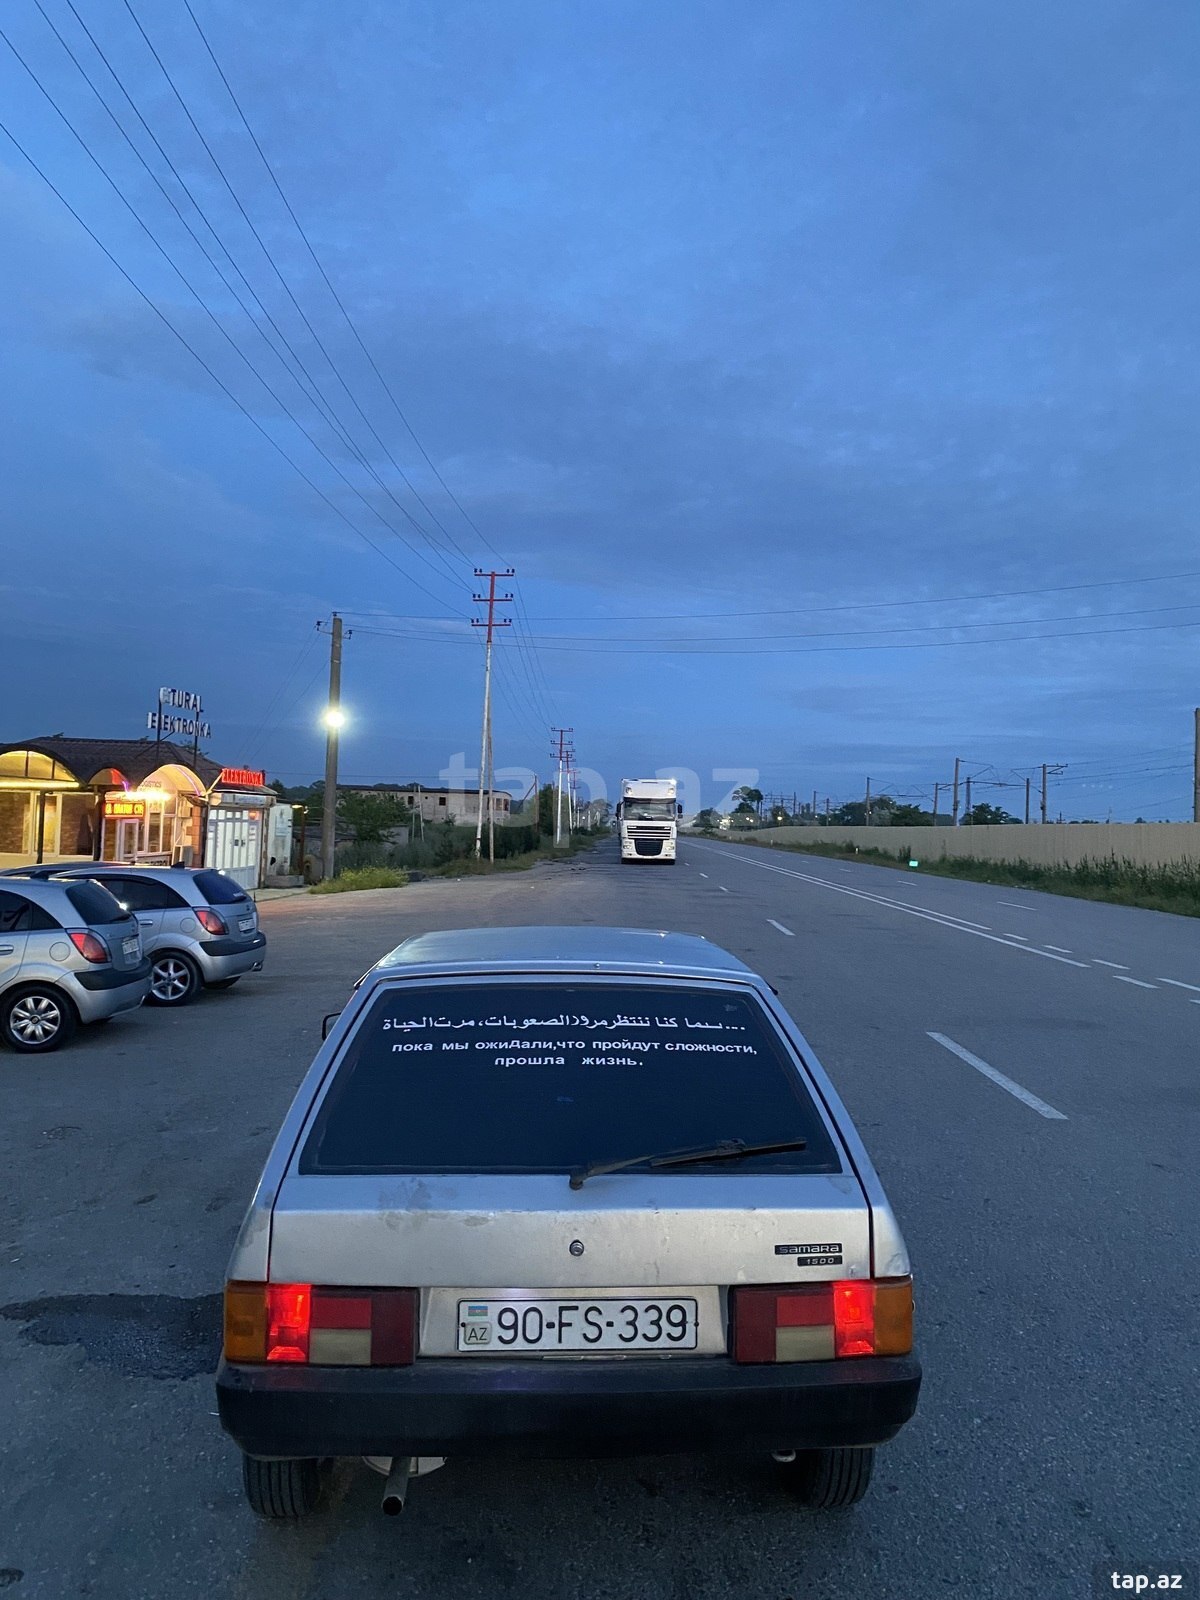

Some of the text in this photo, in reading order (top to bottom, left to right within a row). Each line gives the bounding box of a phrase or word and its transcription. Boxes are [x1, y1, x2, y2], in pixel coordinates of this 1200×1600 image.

[392, 1042, 433, 1052] пока
[442, 1042, 469, 1051] мы
[592, 1038, 661, 1052] пройдут
[664, 1042, 757, 1055] сложности,
[494, 1056, 643, 1068] прошла жизнь.
[806, 1257, 835, 1265] 1500
[497, 1304, 688, 1345] 90-FS-339
[467, 1327, 488, 1341] AZ
